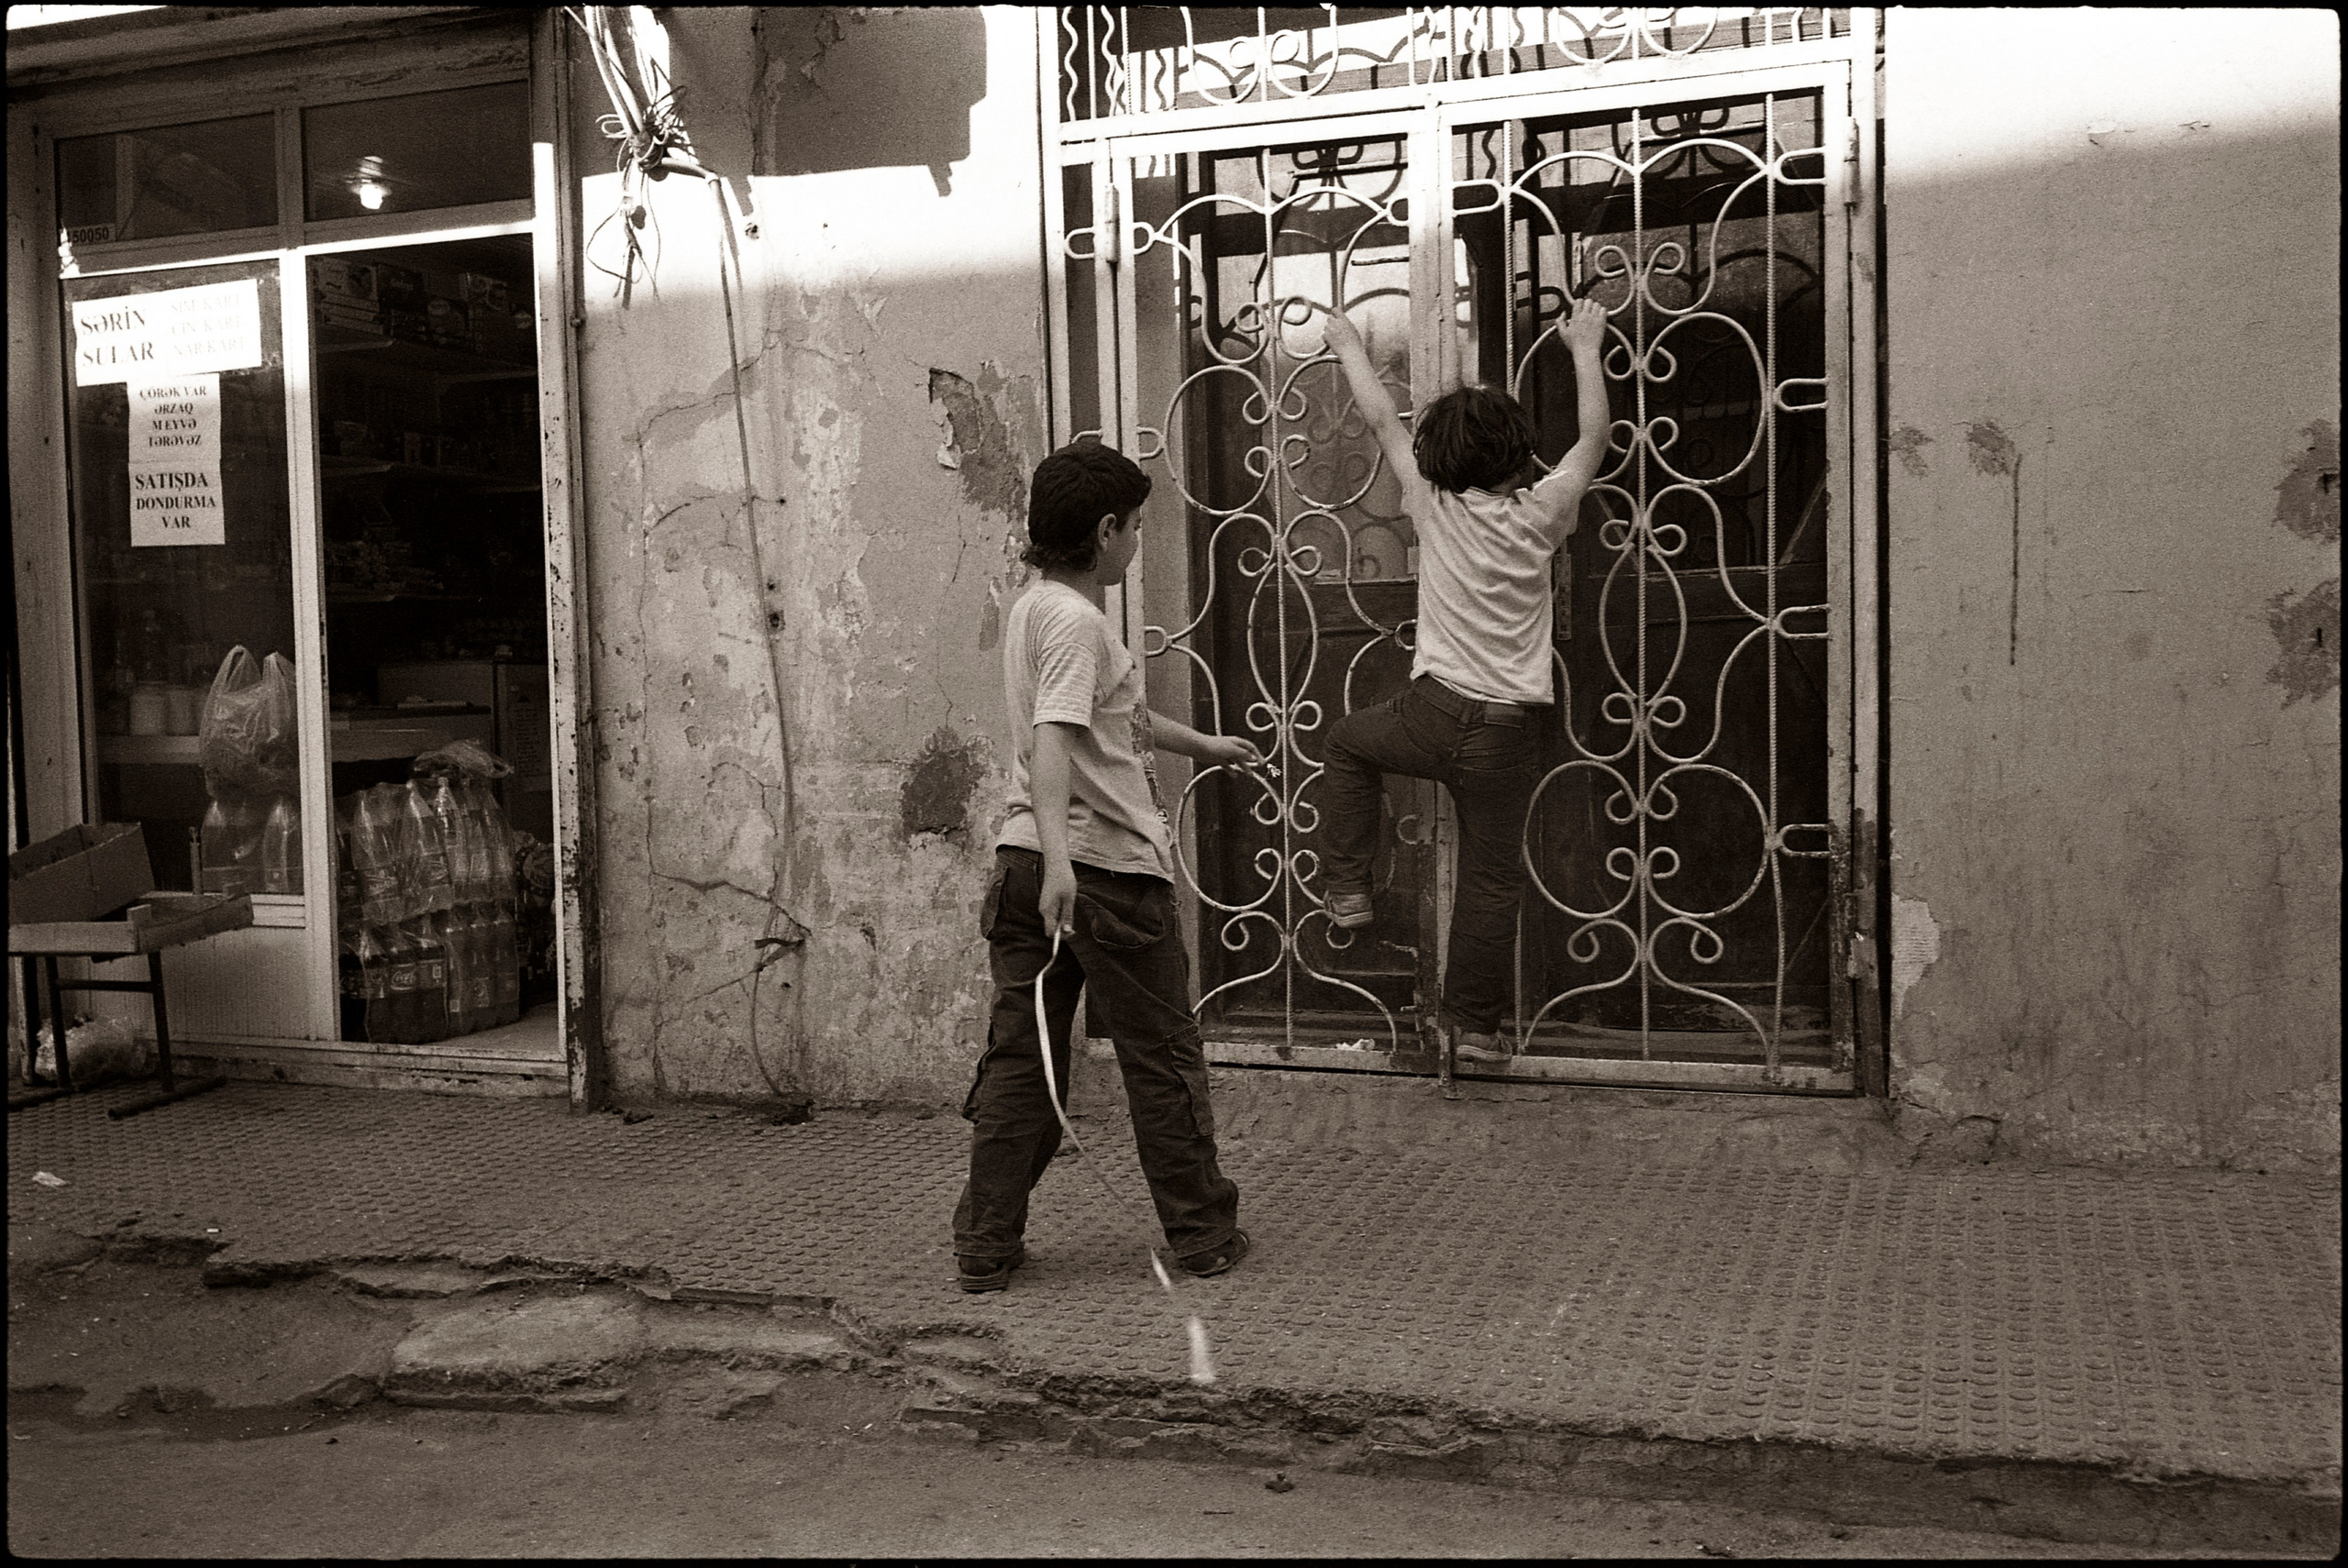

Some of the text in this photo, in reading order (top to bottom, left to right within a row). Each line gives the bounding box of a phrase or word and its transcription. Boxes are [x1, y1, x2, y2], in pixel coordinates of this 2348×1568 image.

[81, 306, 148, 336] SƏRİN
[83, 341, 154, 368] SULAR
[183, 385, 207, 396] VAR
[154, 402, 194, 415] ƏRZAQ
[152, 418, 197, 430] MEYVƏ
[148, 434, 203, 447] TƏRƏVƏZ
[135, 471, 209, 491] SATIŞDA
[136, 495, 216, 511] DONDURMA
[161, 515, 192, 529] VAR
